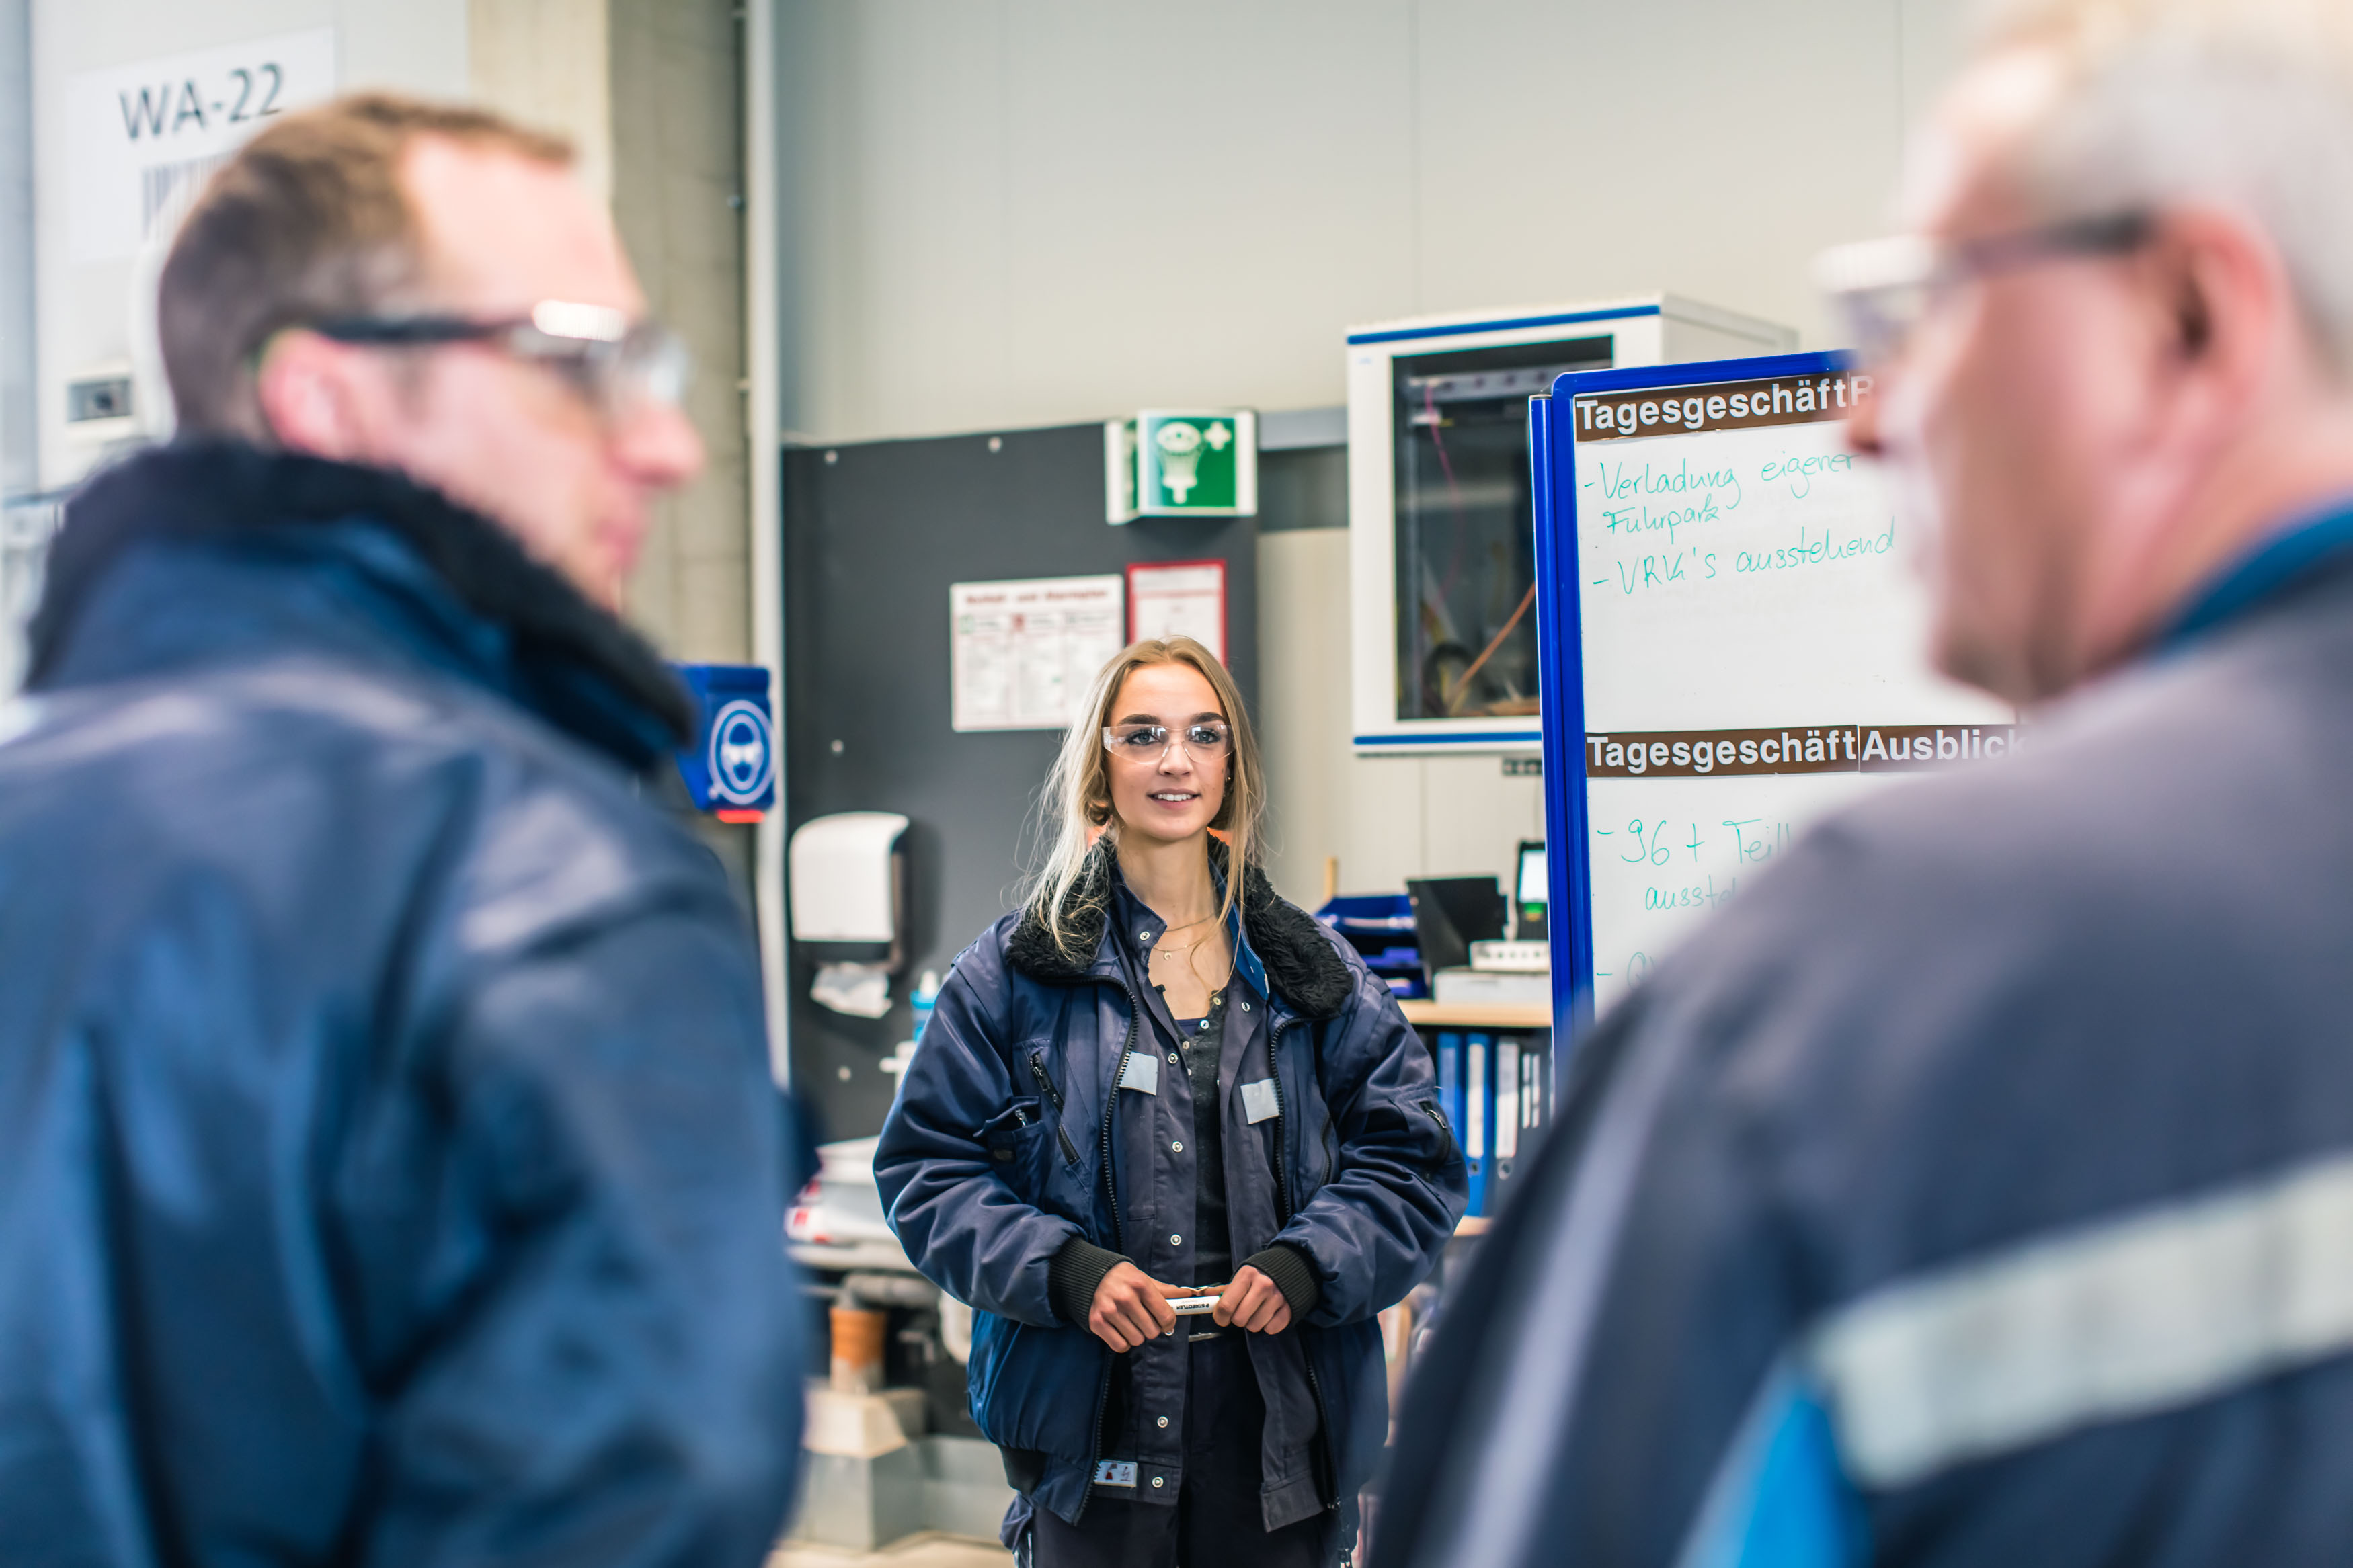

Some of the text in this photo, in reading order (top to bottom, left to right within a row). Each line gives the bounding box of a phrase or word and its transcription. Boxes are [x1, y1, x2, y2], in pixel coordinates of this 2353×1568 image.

[118, 62, 283, 141] WA-22
[1575, 378, 1847, 435] Tagesgeschäft
[1736, 515, 1895, 573] ausstehend
[1587, 729, 1856, 773] Tagesgeschäft
